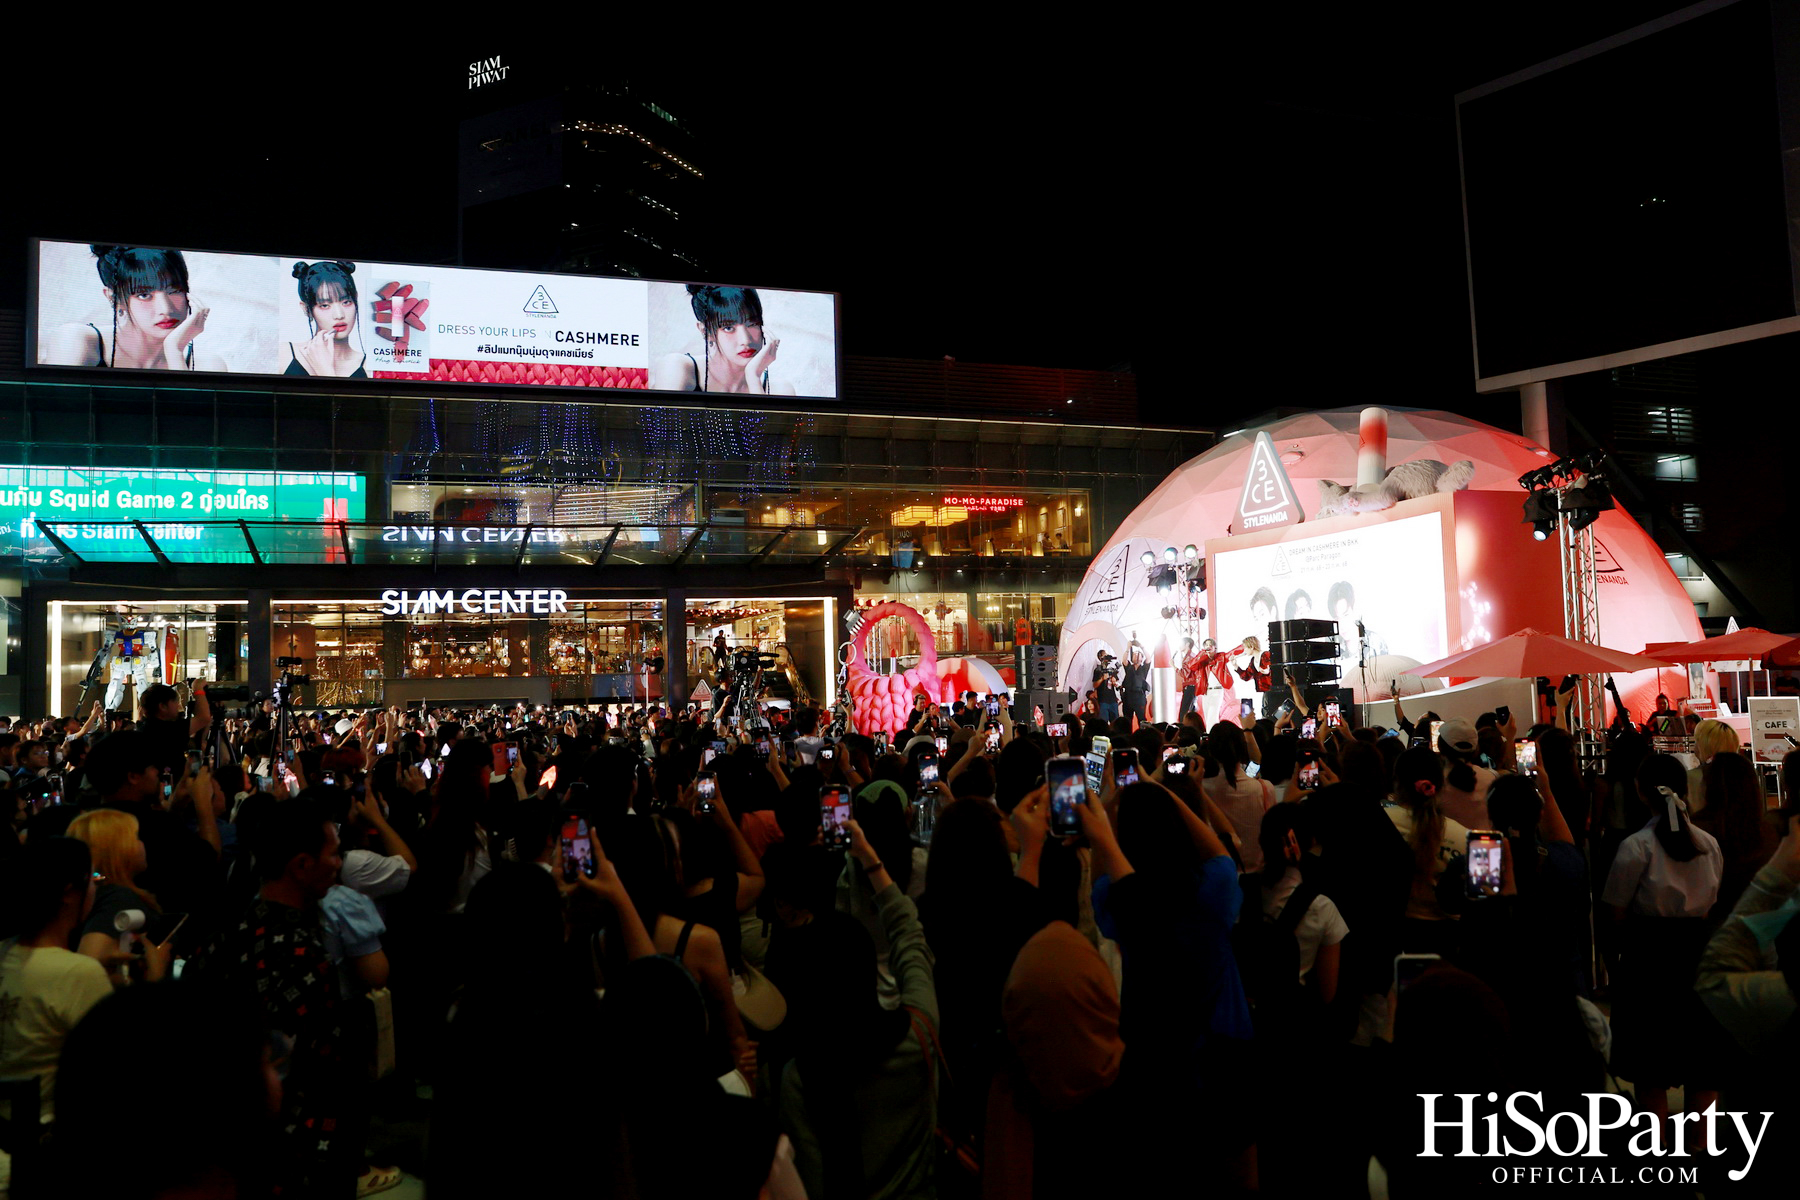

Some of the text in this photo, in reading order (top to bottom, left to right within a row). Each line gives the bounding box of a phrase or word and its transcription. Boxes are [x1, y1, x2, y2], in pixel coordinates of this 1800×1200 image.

[469, 55, 500, 76] SIAM
[468, 66, 510, 90] PIWAT
[438, 324, 476, 335] DRESS
[479, 326, 509, 337] YOUR
[512, 328, 537, 338] LIPS
[555, 330, 640, 347] CASHMERE
[373, 347, 423, 357] CASHMERE
[1257, 459, 1268, 481] 3
[49, 489, 110, 511] Squid
[116, 490, 175, 509] Game
[181, 492, 194, 509] 2
[944, 497, 1024, 506] MO-MO-PARADISE
[1251, 479, 1276, 504] CE
[1243, 510, 1289, 529] STYLENANDA
[82, 523, 135, 540] Siam
[1312, 541, 1340, 552] CASHMERE
[381, 589, 568, 615] SIAM CENTER
[1764, 720, 1788, 729] CAFE
